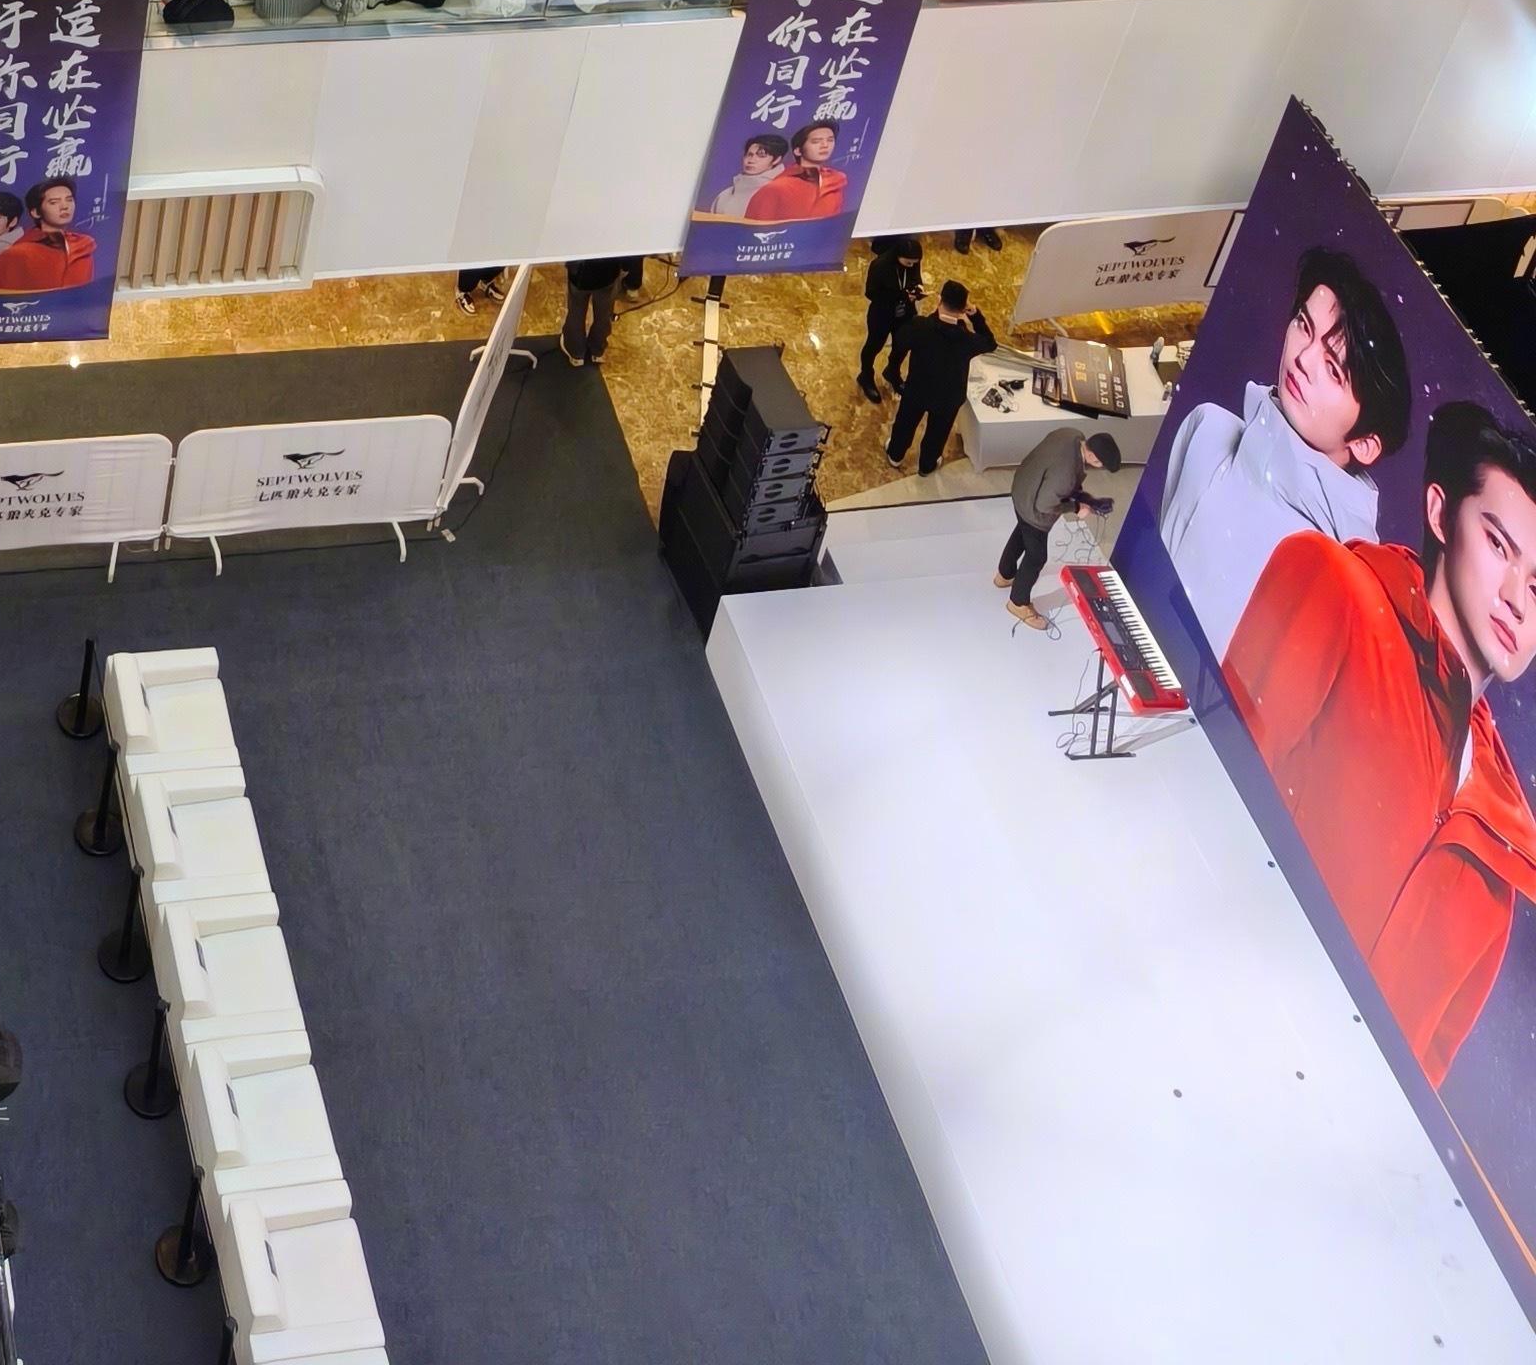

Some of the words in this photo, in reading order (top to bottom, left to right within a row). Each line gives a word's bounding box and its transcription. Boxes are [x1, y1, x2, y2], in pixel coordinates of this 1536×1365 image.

[1096, 255, 1185, 274] SEPTWOLVES
[1094, 268, 1181, 287] 七匹狼夹克专家
[256, 470, 364, 488] SEPTWOLVES
[257, 485, 361, 503] 七匹狼夹克专家
